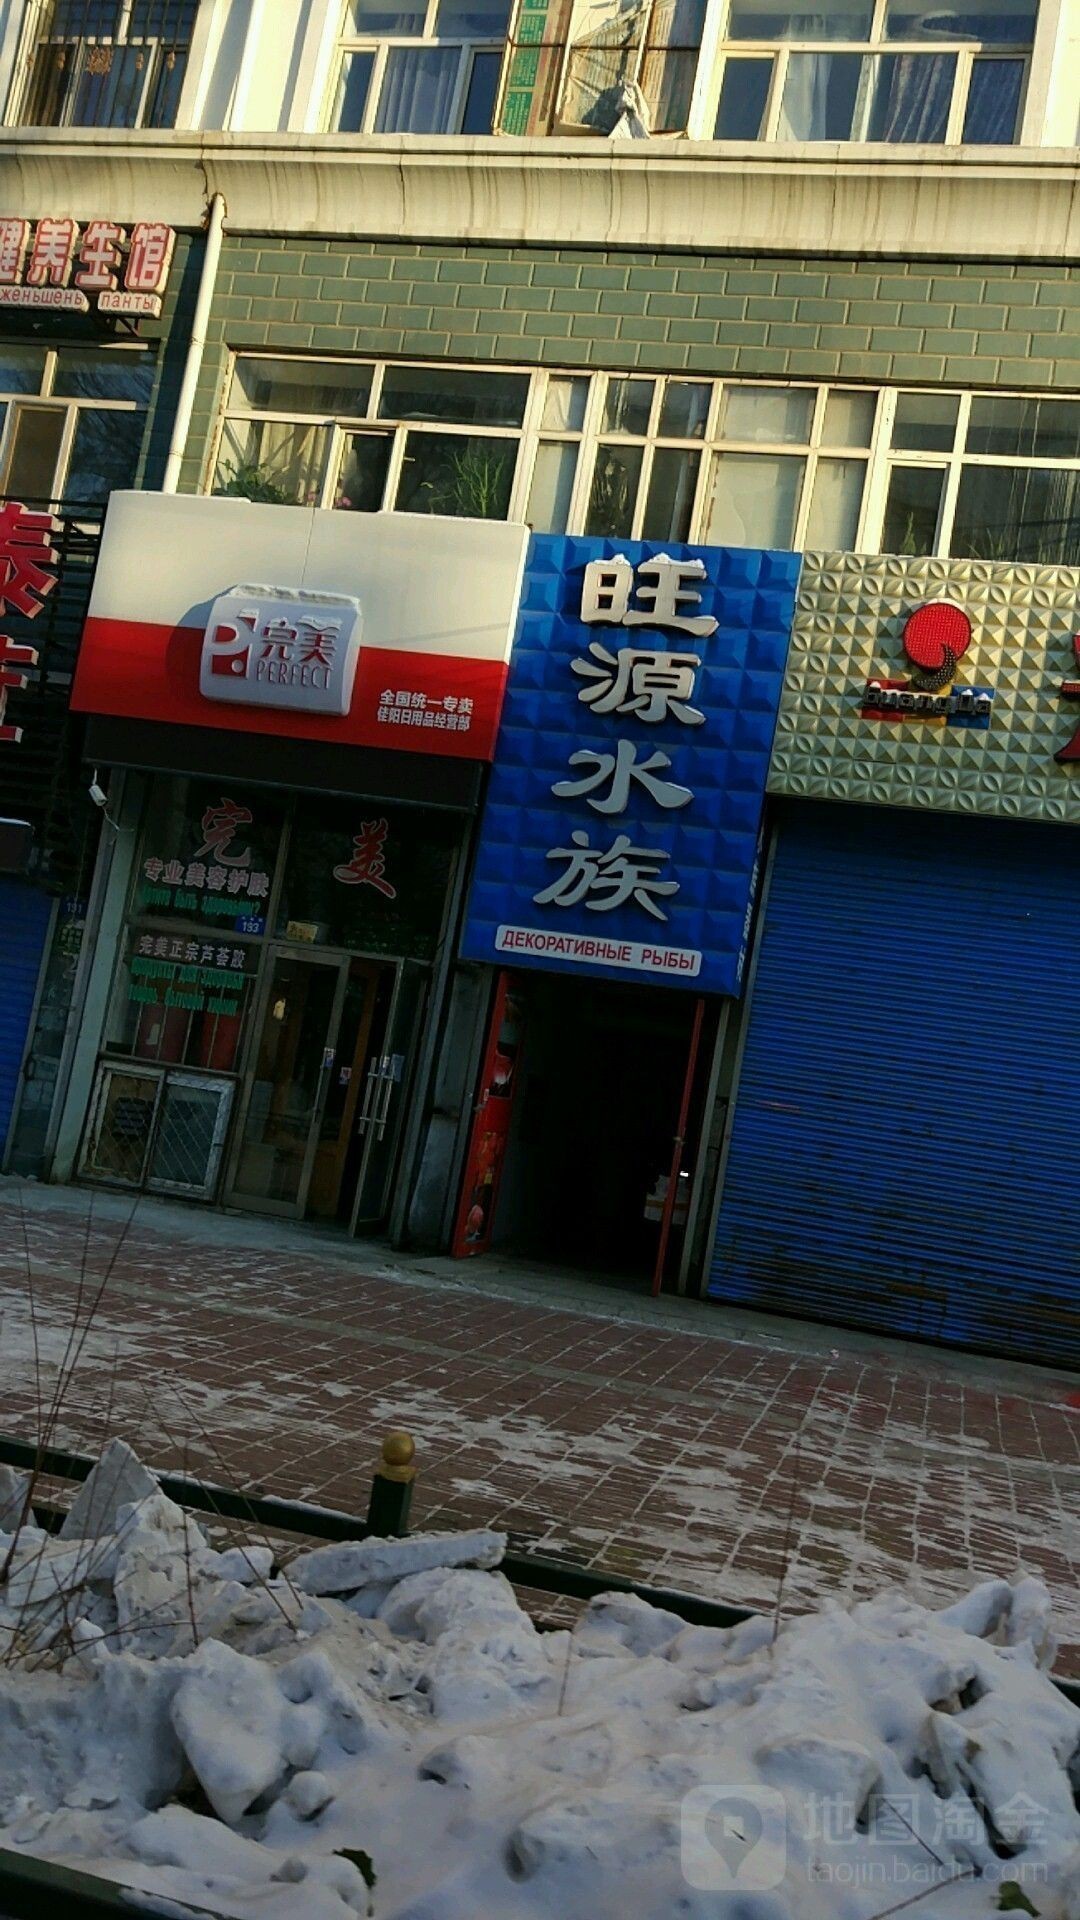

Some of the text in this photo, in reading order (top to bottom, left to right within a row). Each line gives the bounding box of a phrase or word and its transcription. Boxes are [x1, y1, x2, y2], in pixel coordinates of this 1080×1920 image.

[101, 293, 155, 310] панты
[260, 615, 342, 666] 完美
[256, 660, 331, 689] PERFECT
[377, 706, 471, 731] 佳阳日用品经营部
[379, 689, 474, 714] 全国统一专卖
[533, 553, 719, 921] 旺源水族
[144, 856, 269, 898] 专业美容护肤
[138, 934, 246, 969] 完美正宗芦荟胶
[502, 929, 695, 970] ДЕКОРАТИВНЫЕ РЫБЫ
